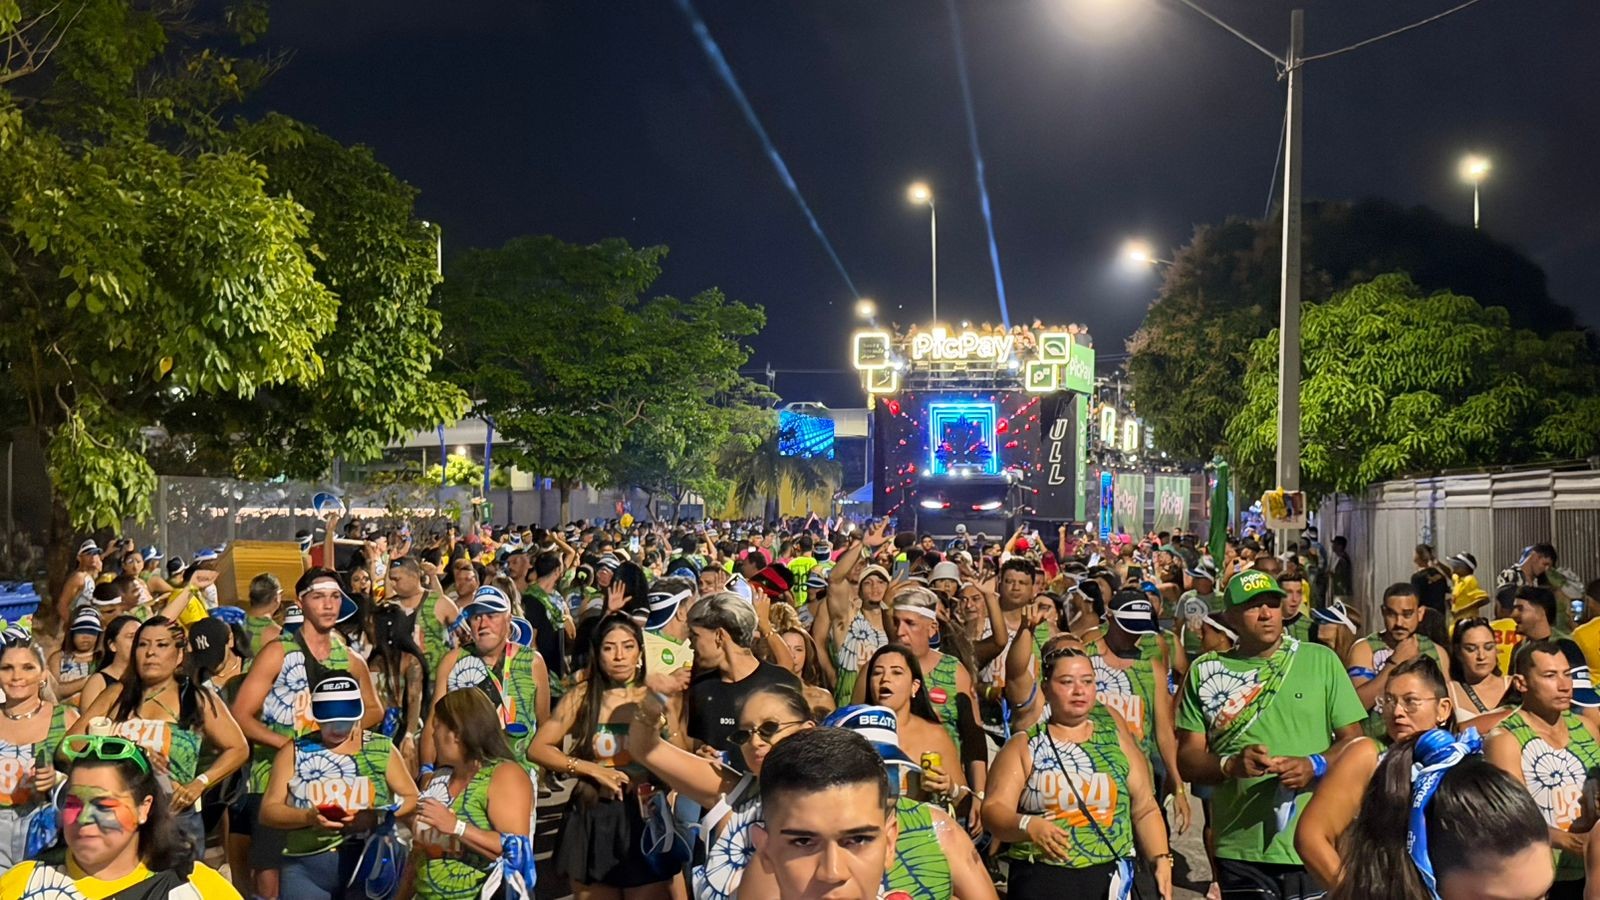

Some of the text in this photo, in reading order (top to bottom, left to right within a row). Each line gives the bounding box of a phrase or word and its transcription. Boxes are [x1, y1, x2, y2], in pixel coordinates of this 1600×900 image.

[912, 328, 1014, 363] PicPay
[1069, 356, 1092, 385] PicPay
[322, 682, 350, 690] BEATS
[859, 715, 896, 729] BEATS
[306, 776, 368, 810] 084
[1041, 771, 1110, 812] 084
